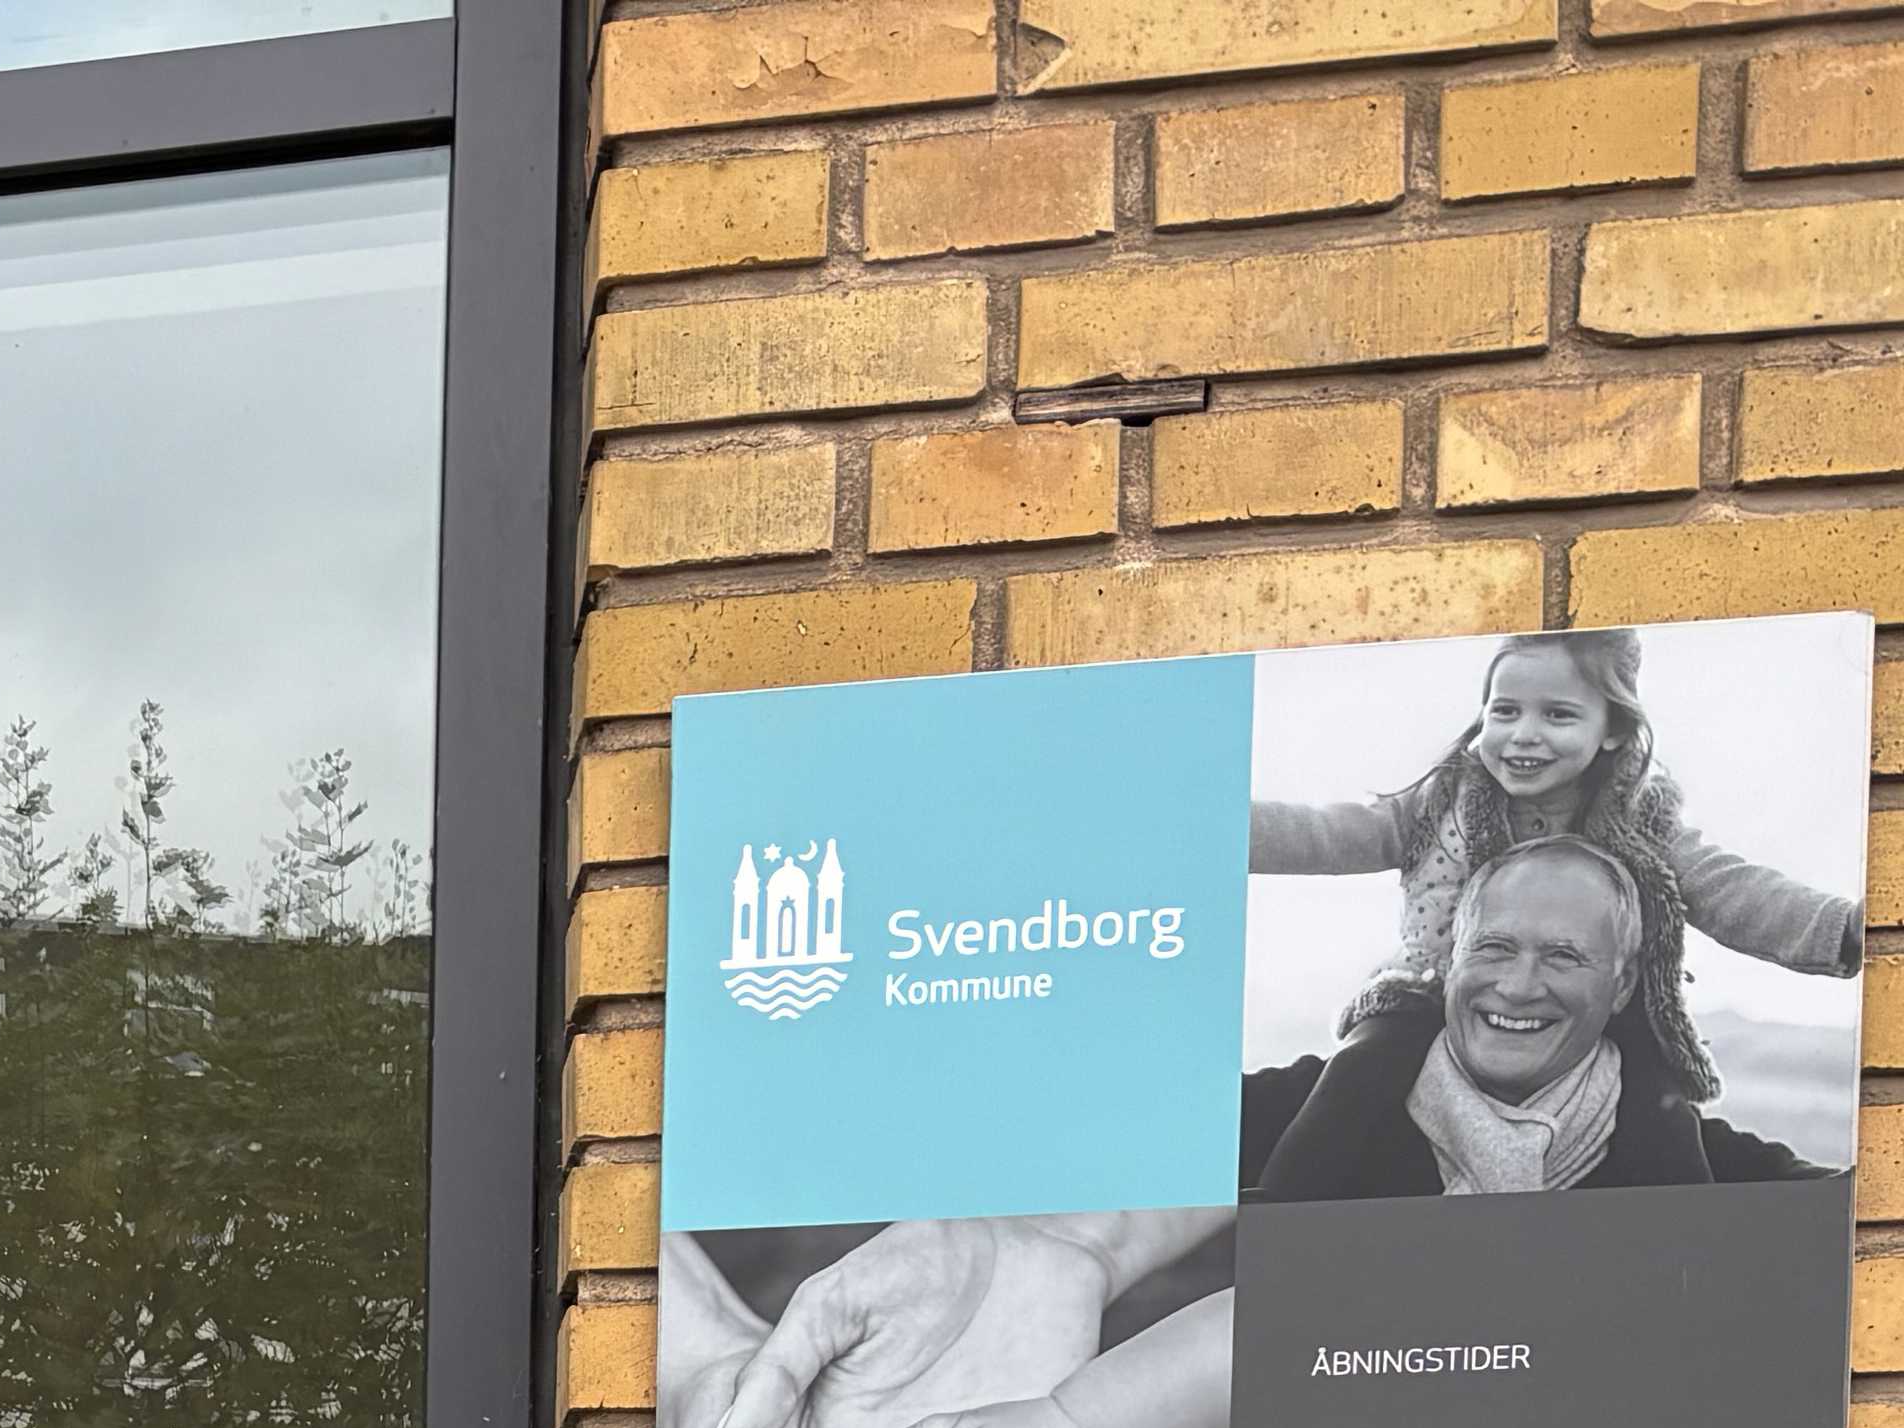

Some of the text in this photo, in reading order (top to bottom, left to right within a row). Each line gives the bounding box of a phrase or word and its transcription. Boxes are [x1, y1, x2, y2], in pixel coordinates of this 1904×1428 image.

[887, 898, 1186, 961] Svendborg
[884, 971, 1054, 1008] Kommune
[1310, 1343, 1531, 1377] ÅBNINGSTIDER
